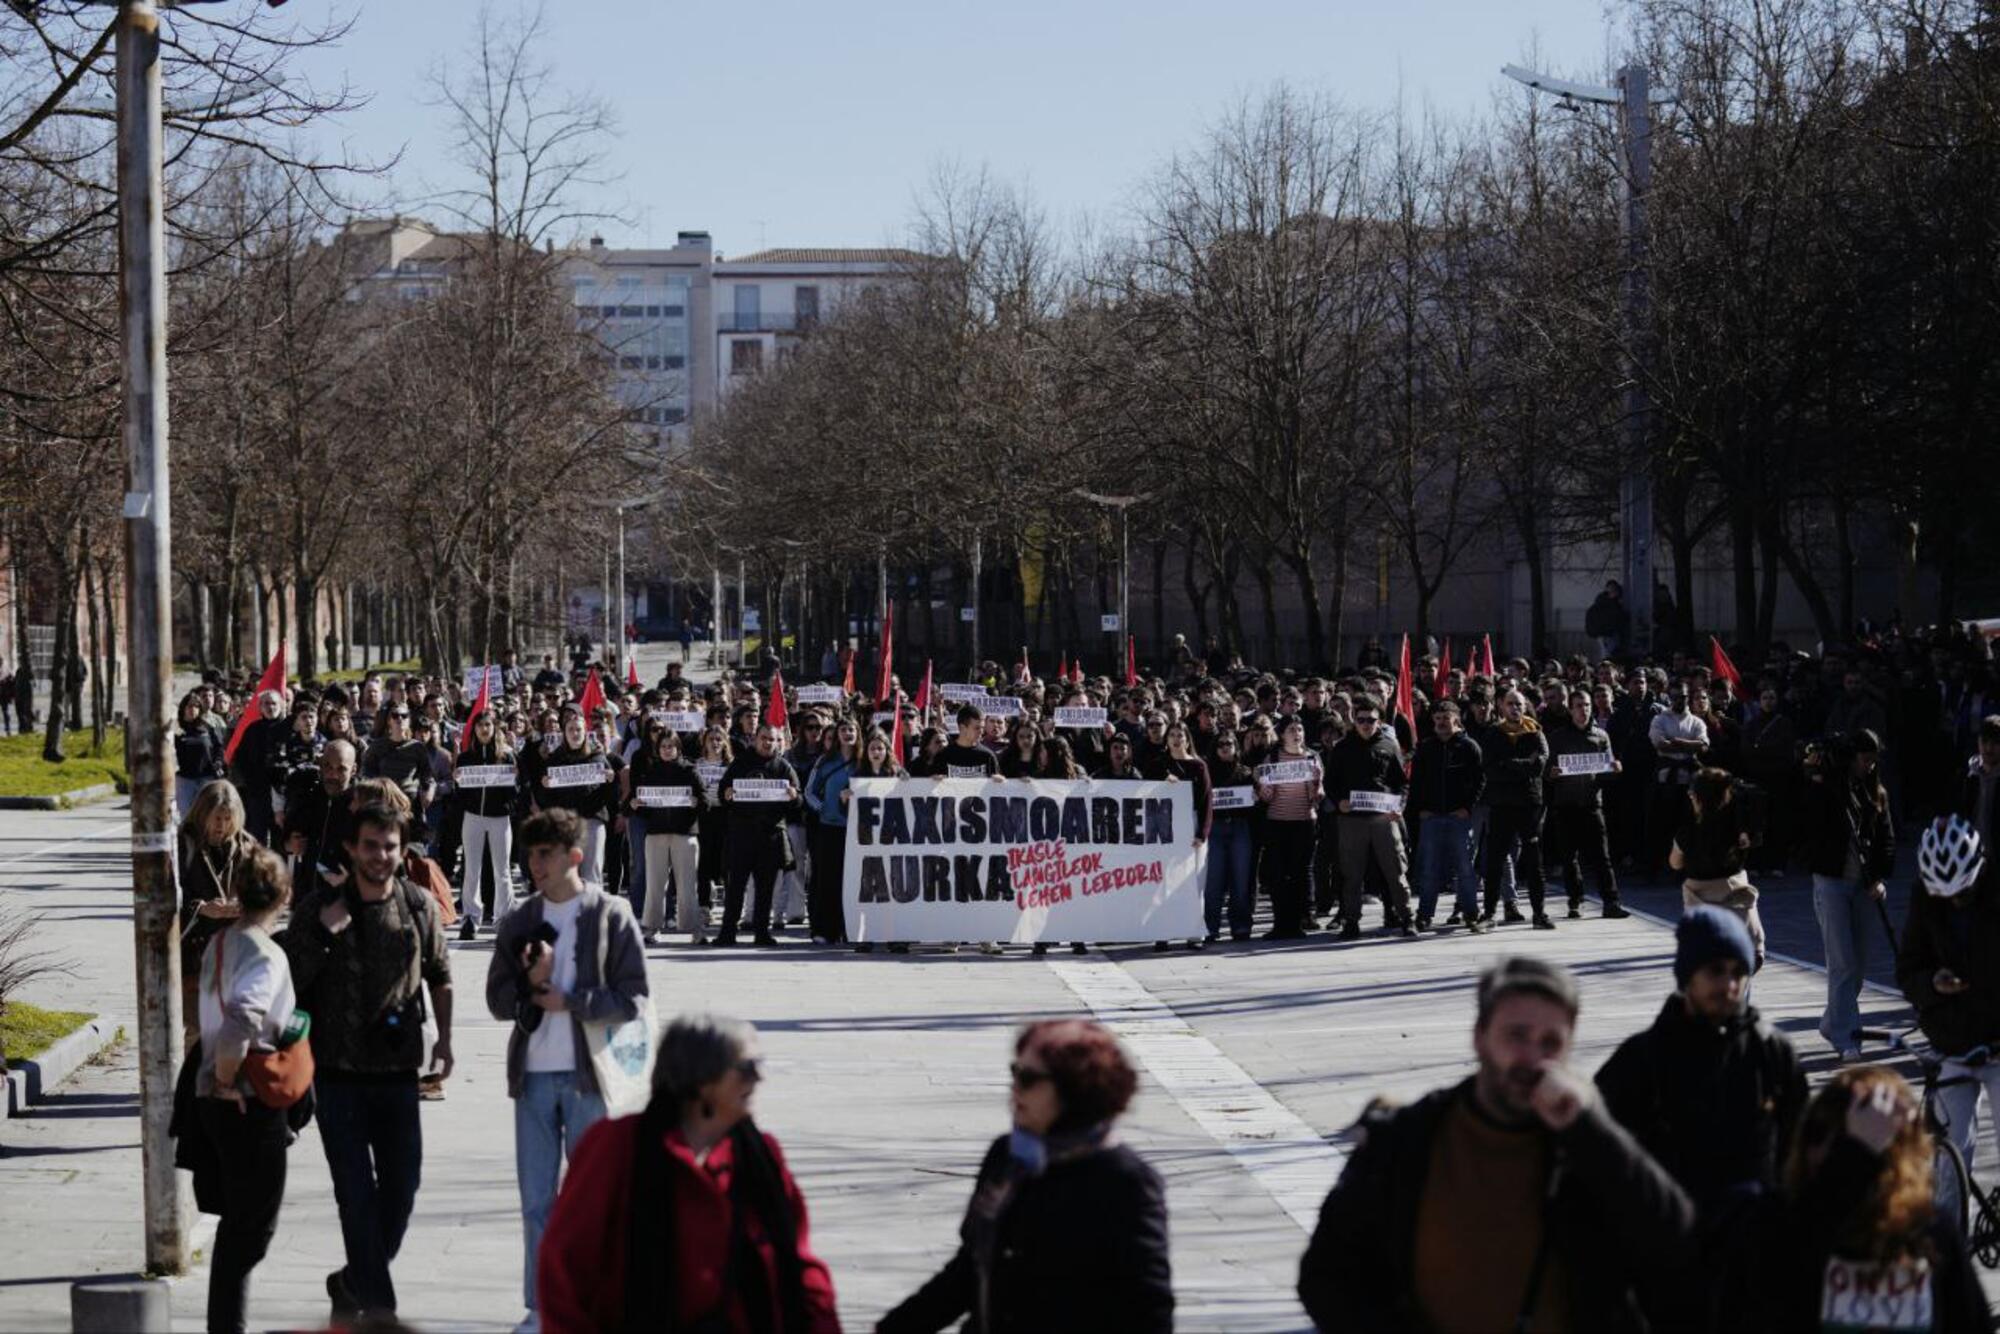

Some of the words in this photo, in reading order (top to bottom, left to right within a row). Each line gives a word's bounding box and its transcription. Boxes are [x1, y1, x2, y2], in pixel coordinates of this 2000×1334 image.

[857, 796, 1174, 845] FAXISMOAREN
[859, 854, 1014, 904] AURKA
[1006, 839, 1066, 871] IKASLE
[1012, 852, 1104, 889] LANGILEOK
[1016, 882, 1073, 911] LEHEN
[1082, 861, 1164, 896] LERRORA!
